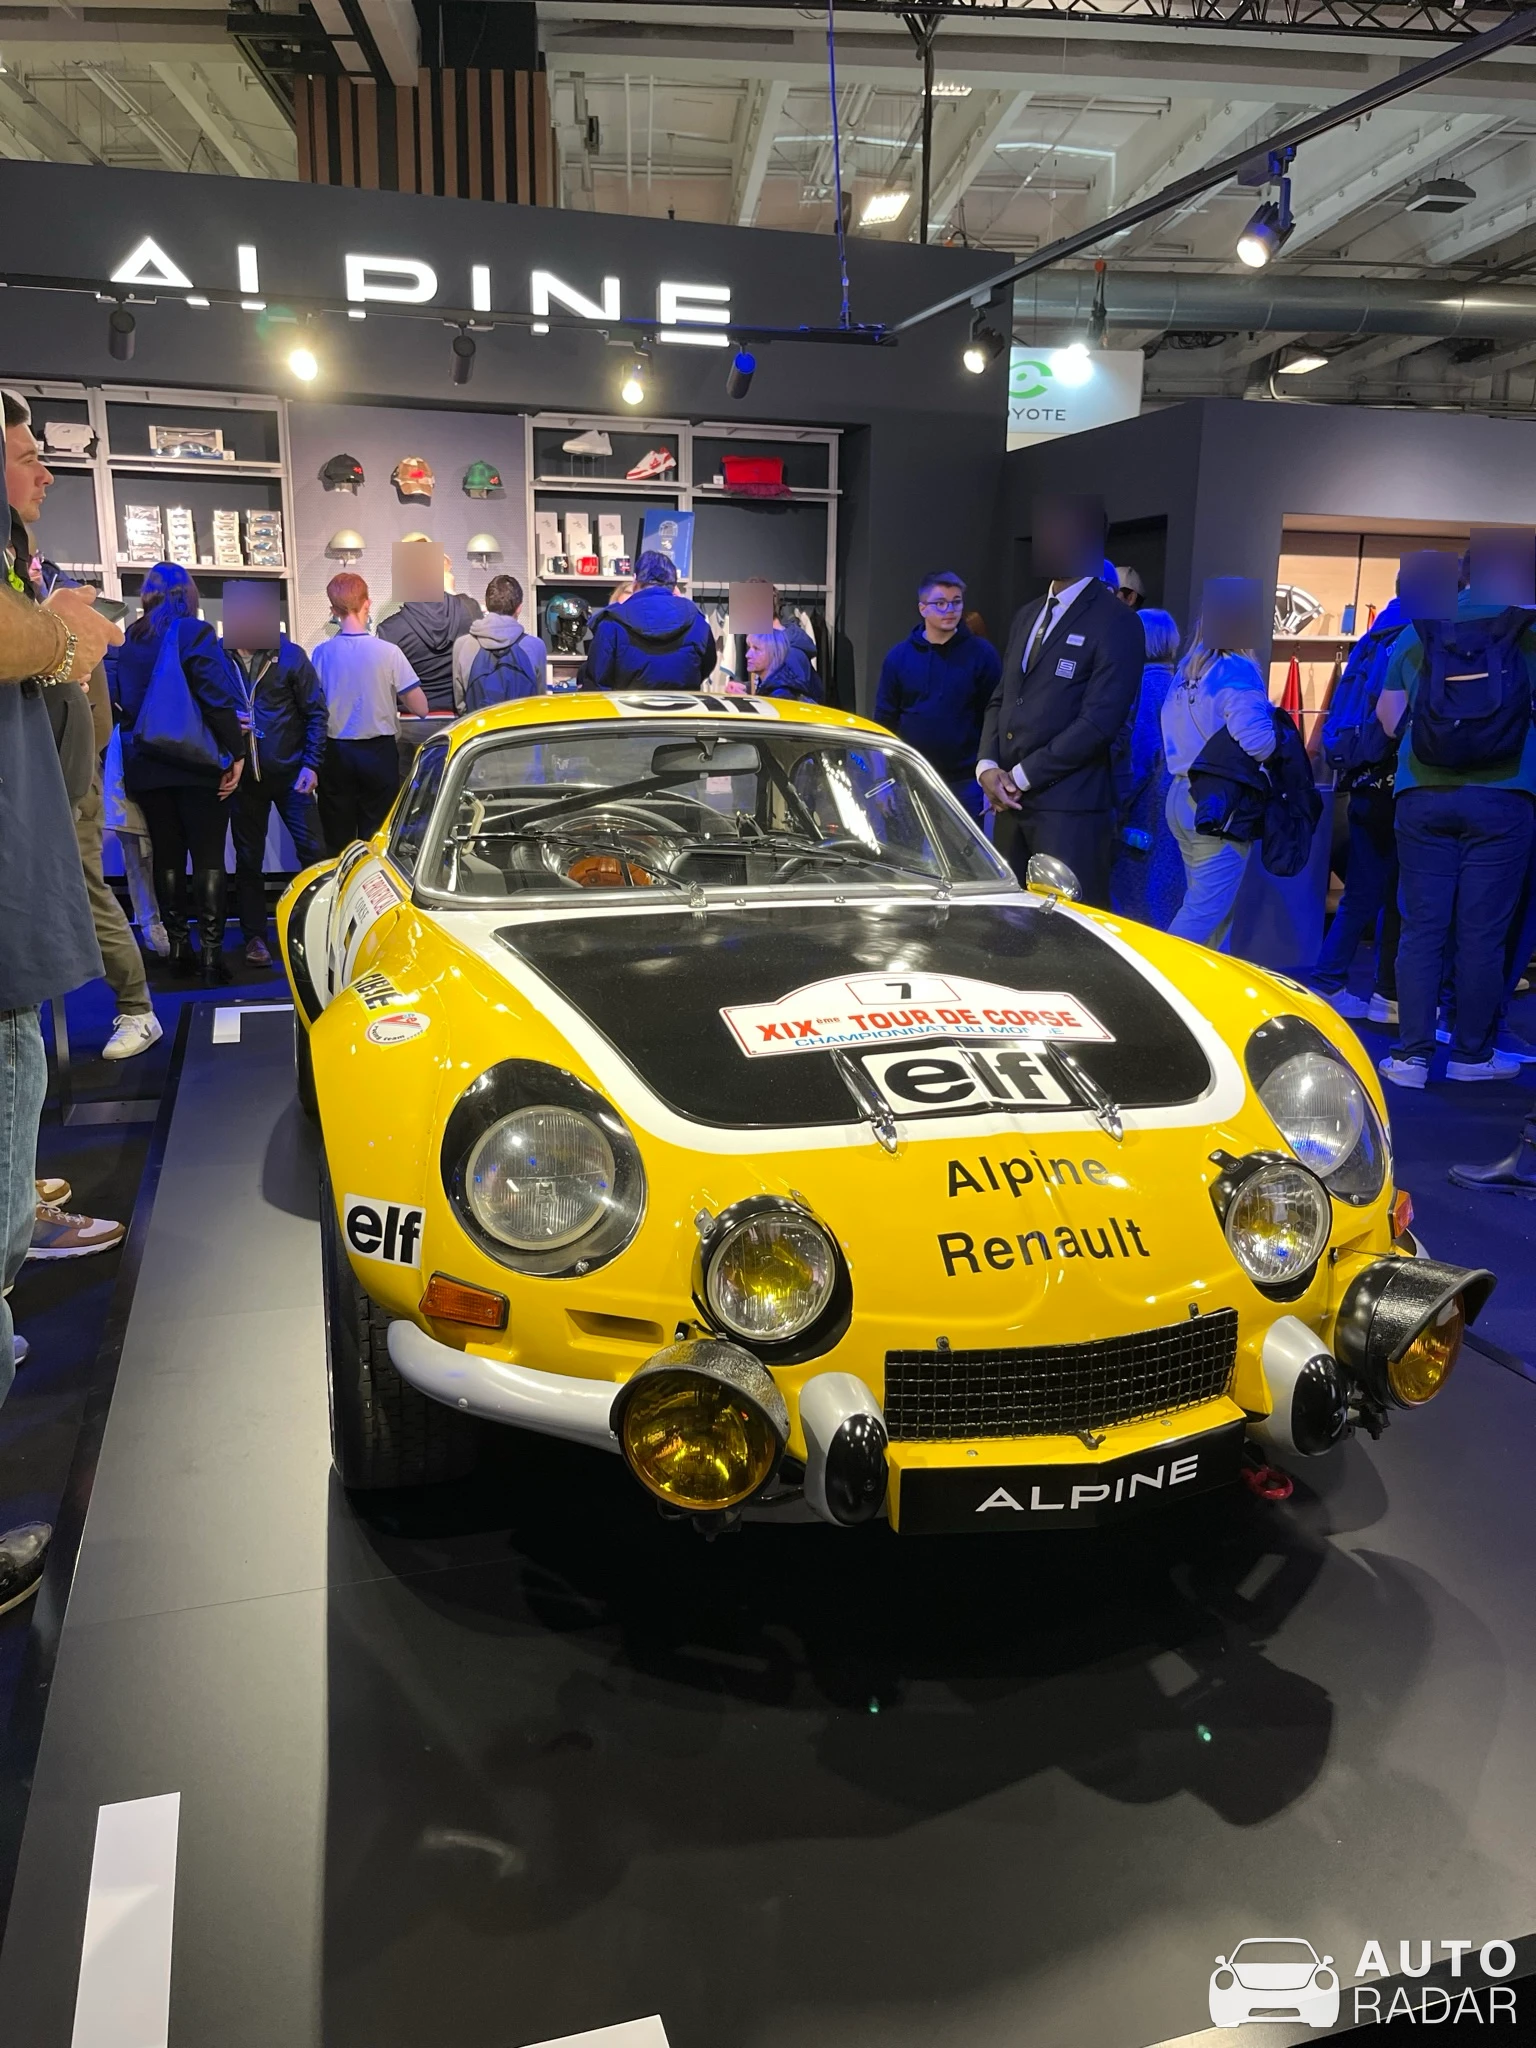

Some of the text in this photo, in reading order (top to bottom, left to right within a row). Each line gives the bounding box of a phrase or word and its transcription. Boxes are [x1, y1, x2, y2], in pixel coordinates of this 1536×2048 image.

[110, 236, 731, 347] ALPINE
[617, 694, 762, 715] elf
[885, 982, 912, 1000] 7
[794, 1024, 949, 1049] CHAMPIONNAT
[955, 1024, 985, 1035] DU
[848, 1008, 932, 1032] TOUR
[937, 1008, 982, 1026] DE
[982, 1009, 1083, 1028] CORSE
[883, 1050, 1047, 1105] elf
[947, 1149, 1111, 1198] Alpine
[346, 1205, 422, 1264] elf
[937, 1217, 1151, 1277] Renault
[975, 1454, 1199, 1512] ALPINE
